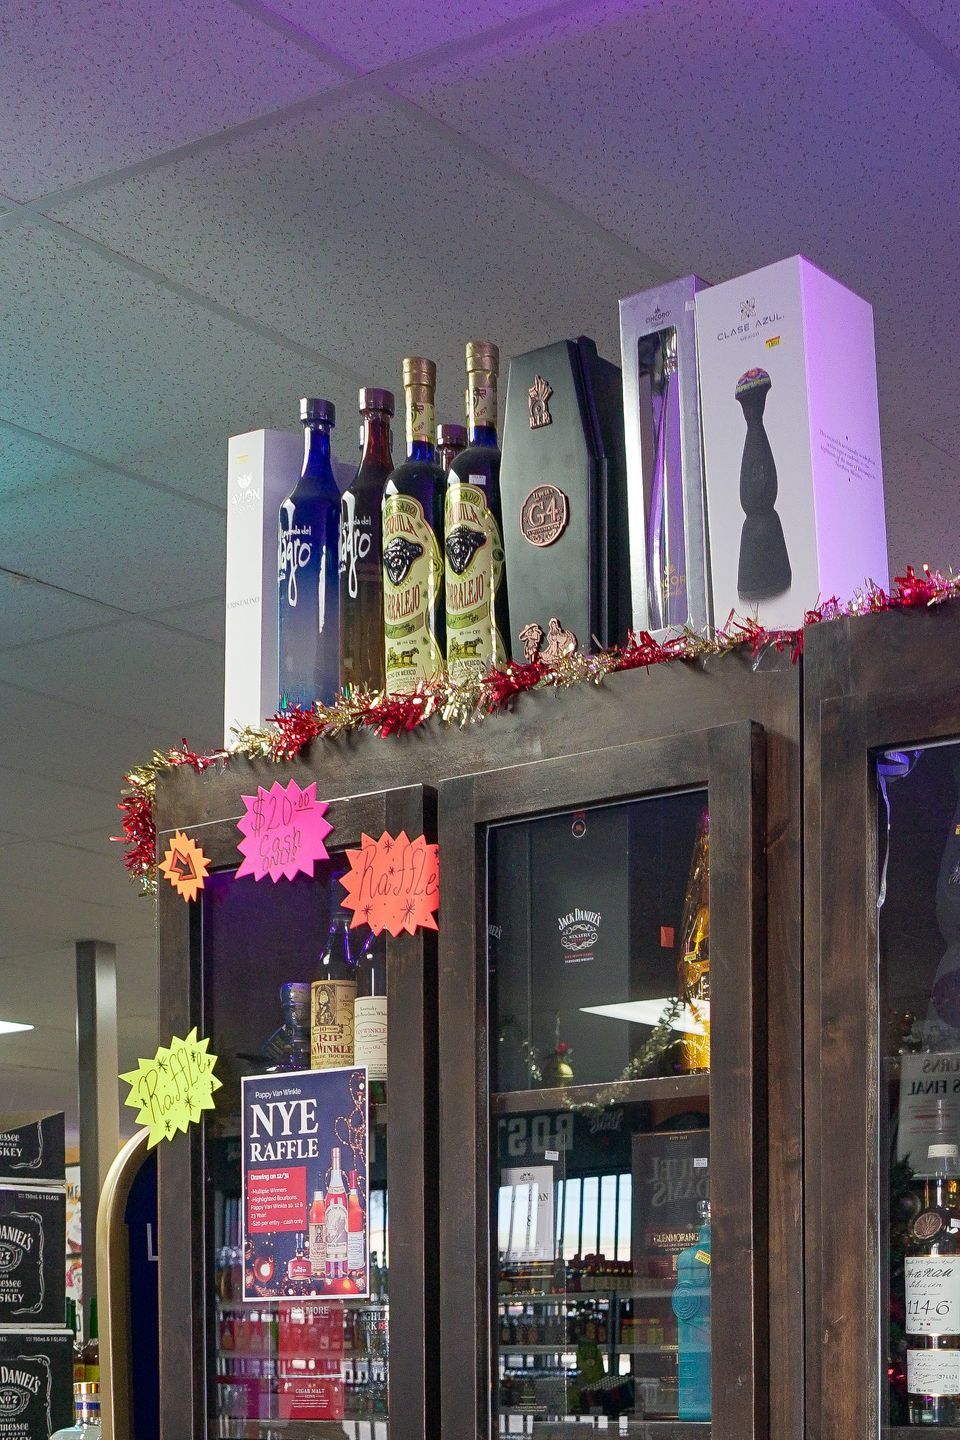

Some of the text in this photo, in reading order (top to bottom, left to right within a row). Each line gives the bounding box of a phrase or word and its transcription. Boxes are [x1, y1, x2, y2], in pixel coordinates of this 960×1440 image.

[717, 313, 783, 341] CLASE AZUL
[529, 499, 560, 527] G4
[558, 908, 602, 931] JACK DANIEL'S
[255, 1088, 301, 1099] Pappy Van Winkle
[250, 1099, 319, 1137] NYE
[250, 1138, 319, 1163] RAFFLE
[907, 1299, 950, 1316] 1146
[1, 1366, 41, 1394] DANIEL'S
